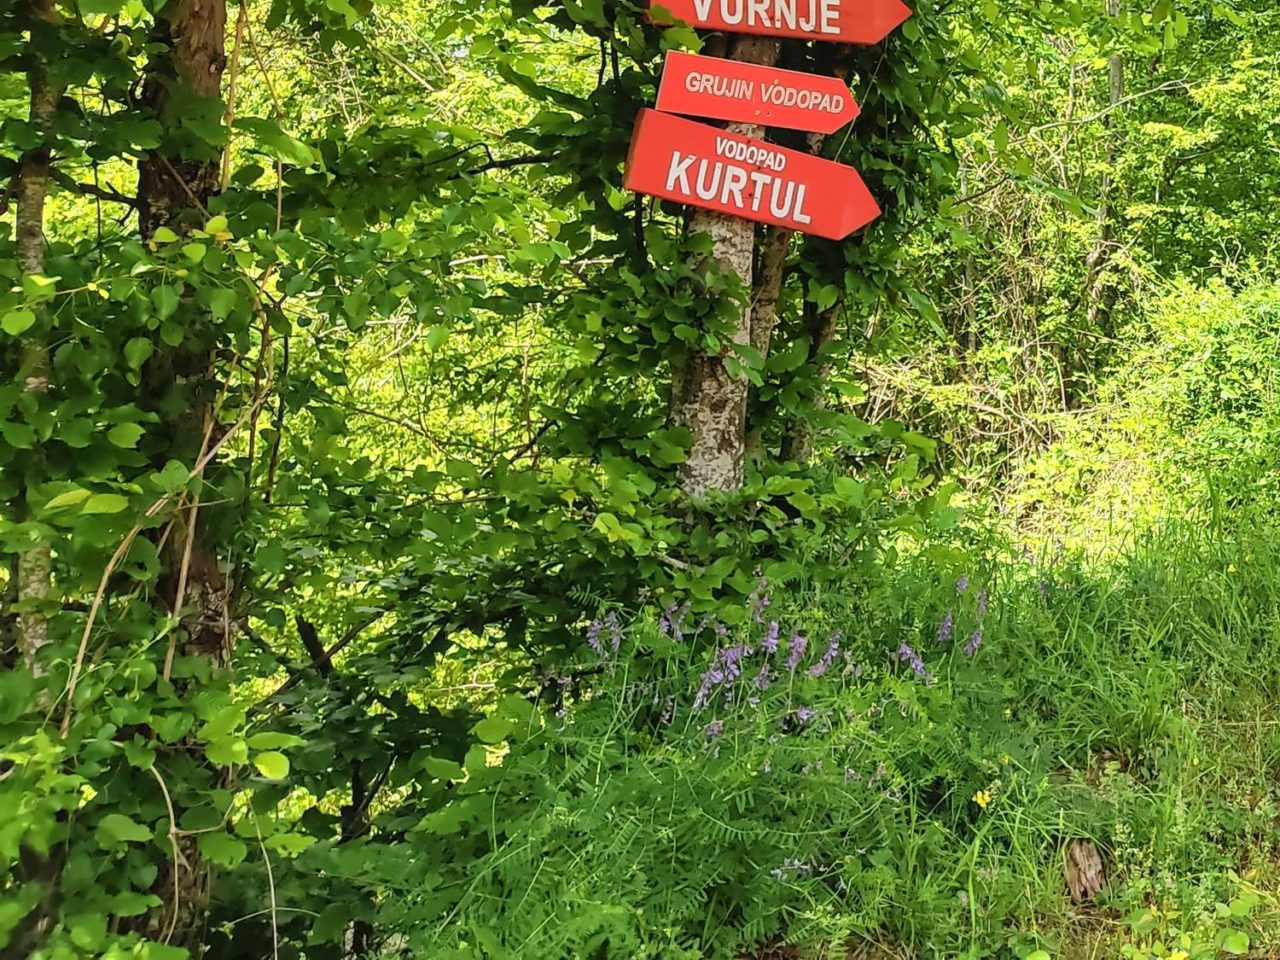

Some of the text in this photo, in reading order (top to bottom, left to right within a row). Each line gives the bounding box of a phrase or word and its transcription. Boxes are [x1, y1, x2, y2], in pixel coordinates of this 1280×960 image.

[684, 71, 844, 114] GRUJIN VODOPAD
[715, 136, 786, 171] VODOPAD
[665, 150, 811, 225] KURTUL
